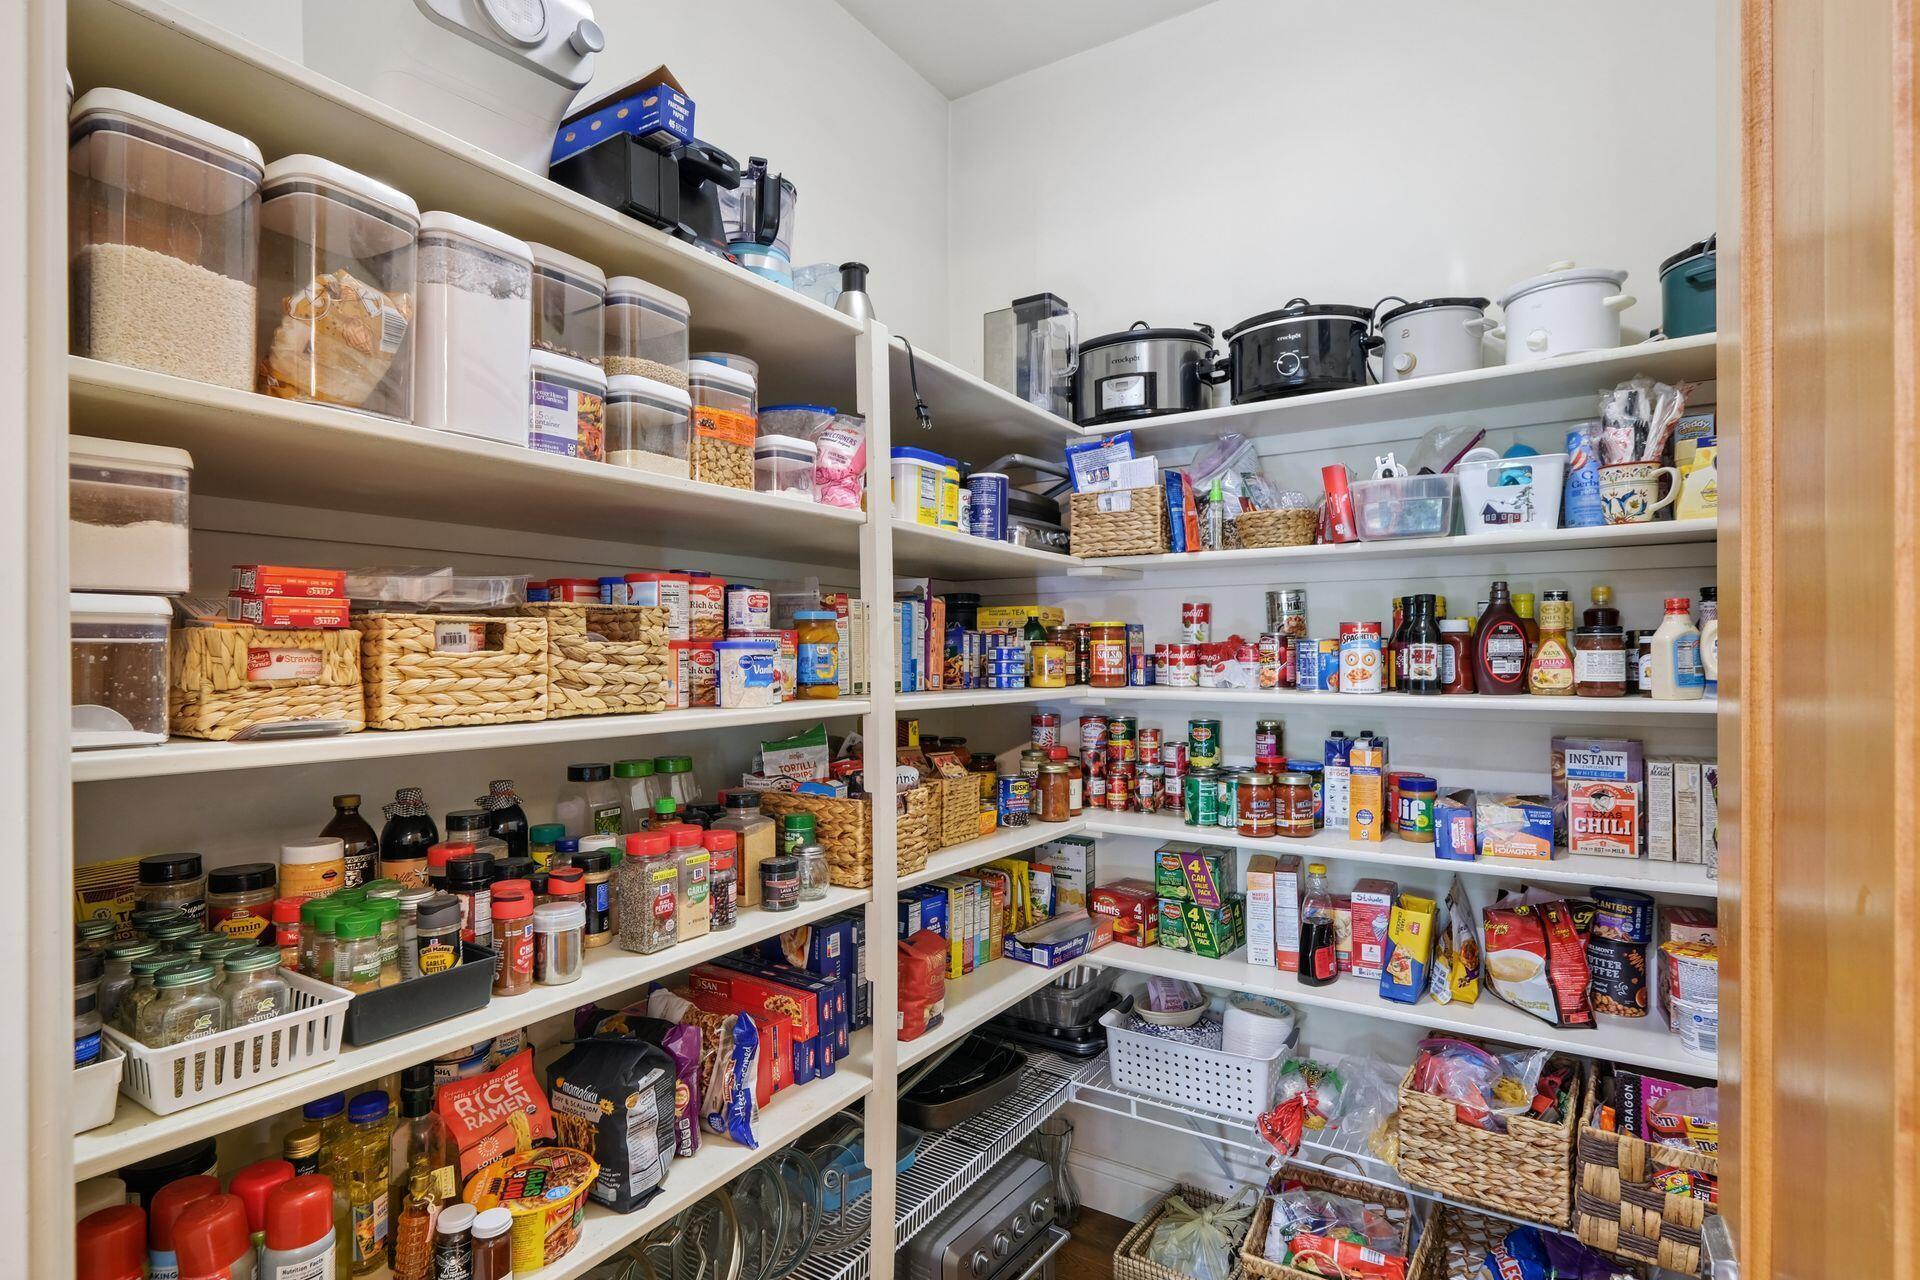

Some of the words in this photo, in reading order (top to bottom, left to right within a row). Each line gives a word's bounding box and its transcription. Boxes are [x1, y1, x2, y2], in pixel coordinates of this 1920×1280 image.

[668, 100, 689, 116] PARCHMENT
[672, 110, 684, 121] PAPER
[668, 119, 676, 129] 45
[1277, 332, 1302, 342] crockpot
[1112, 355, 1140, 366] crockpot
[690, 600, 707, 609] Rich
[708, 601, 714, 609] &
[1097, 651, 1121, 660] SALSA
[1568, 754, 1624, 766] INSTANT
[778, 761, 817, 774] TORTILLA
[1584, 810, 1623, 820] TEXAS
[1574, 816, 1632, 836] CHILI
[1494, 846, 1538, 856] SANDWICH
[1188, 860, 1200, 874] 4
[1192, 874, 1206, 883] CAN
[688, 886, 709, 895] GARLIC
[1198, 888, 1211, 897] PACK
[655, 904, 674, 912] PEPPER
[1093, 901, 1120, 916] Hunt's
[1134, 904, 1143, 914] 4
[1234, 904, 1240, 918] 4
[1188, 908, 1200, 922] 4
[220, 922, 261, 934] Cumin
[1190, 922, 1204, 932] CAN
[1197, 938, 1210, 946] PACK
[1054, 942, 1073, 956] Reynolds
[1052, 955, 1063, 964] FOIL
[702, 980, 718, 990] SAN
[500, 1038, 522, 1048] SHOOTS
[454, 1086, 481, 1101] MILLET
[488, 1067, 520, 1084] BROWN
[454, 1074, 524, 1118] RICE
[562, 1080, 599, 1104] momofuku
[570, 1100, 599, 1114] SCALLION
[734, 1090, 747, 1117] Herb
[1624, 1083, 1634, 1131] DRAGON
[463, 1090, 532, 1132] RAMEN
[562, 1106, 586, 1118] NOODLES
[476, 1152, 504, 1171] LOTUS
[524, 1168, 546, 1196] SPICY
[502, 1178, 526, 1200] HOT
[282, 1265, 308, 1276] Nutrition
[309, 1258, 324, 1268] Facts
